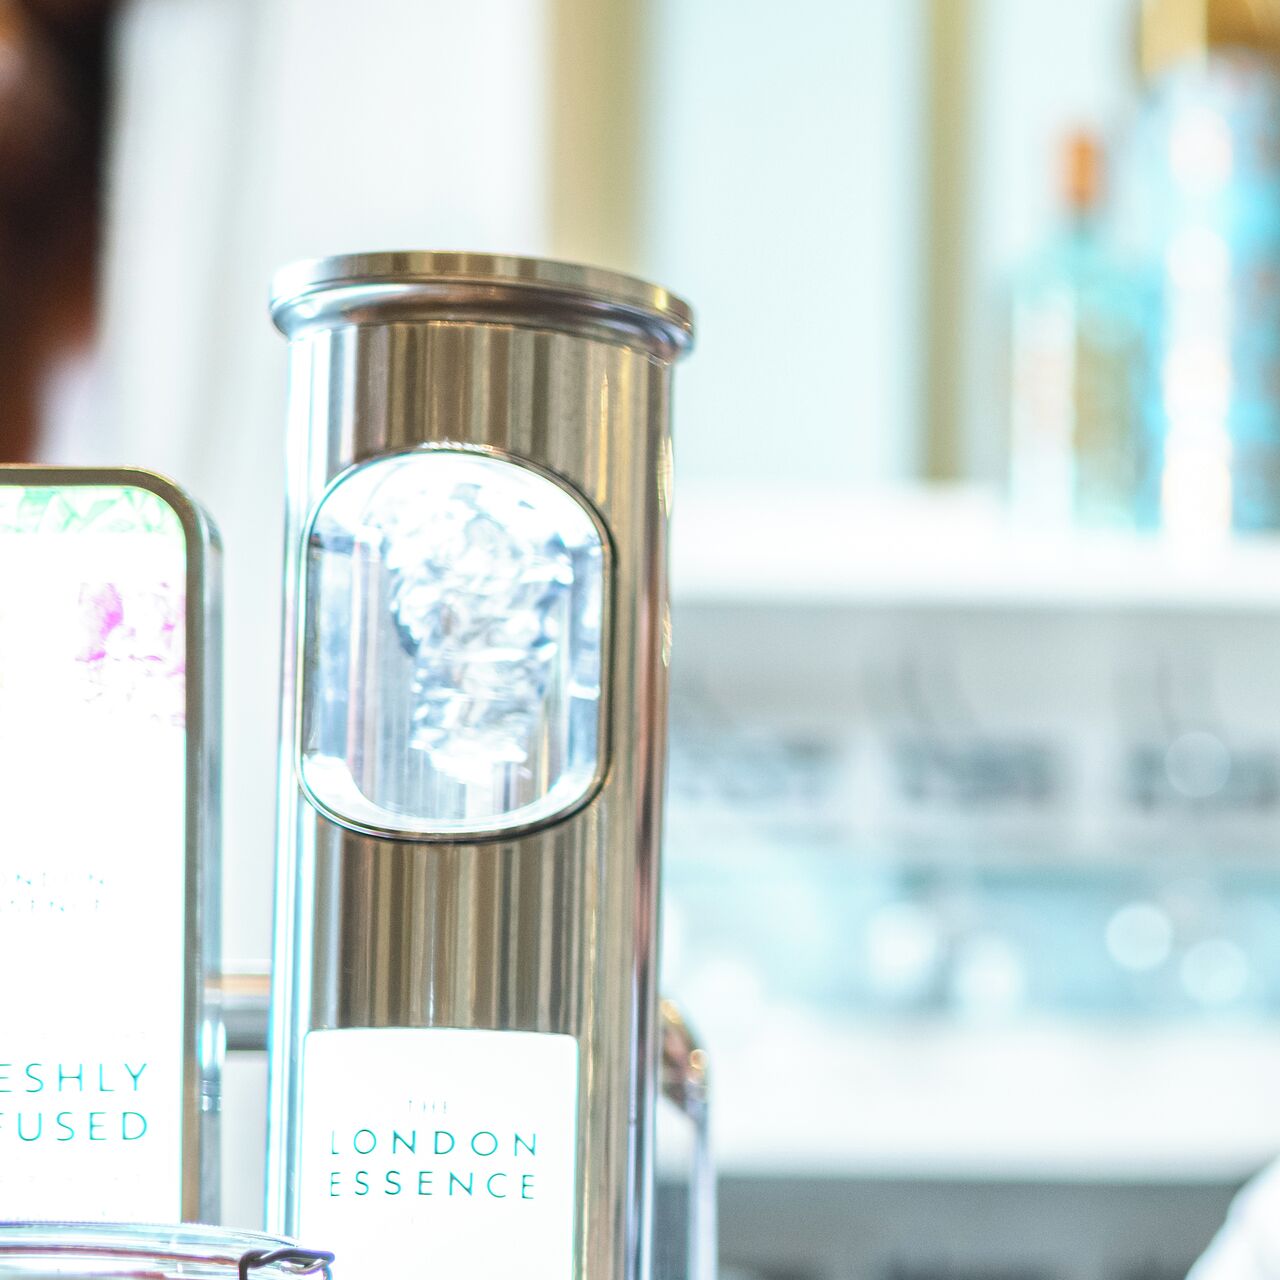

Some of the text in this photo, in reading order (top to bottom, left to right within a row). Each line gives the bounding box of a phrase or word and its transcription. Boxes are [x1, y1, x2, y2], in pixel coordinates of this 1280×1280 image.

[0, 1111, 148, 1142] USED
[330, 1127, 538, 1158] LONDON
[330, 1169, 535, 1200] ESSENCE
